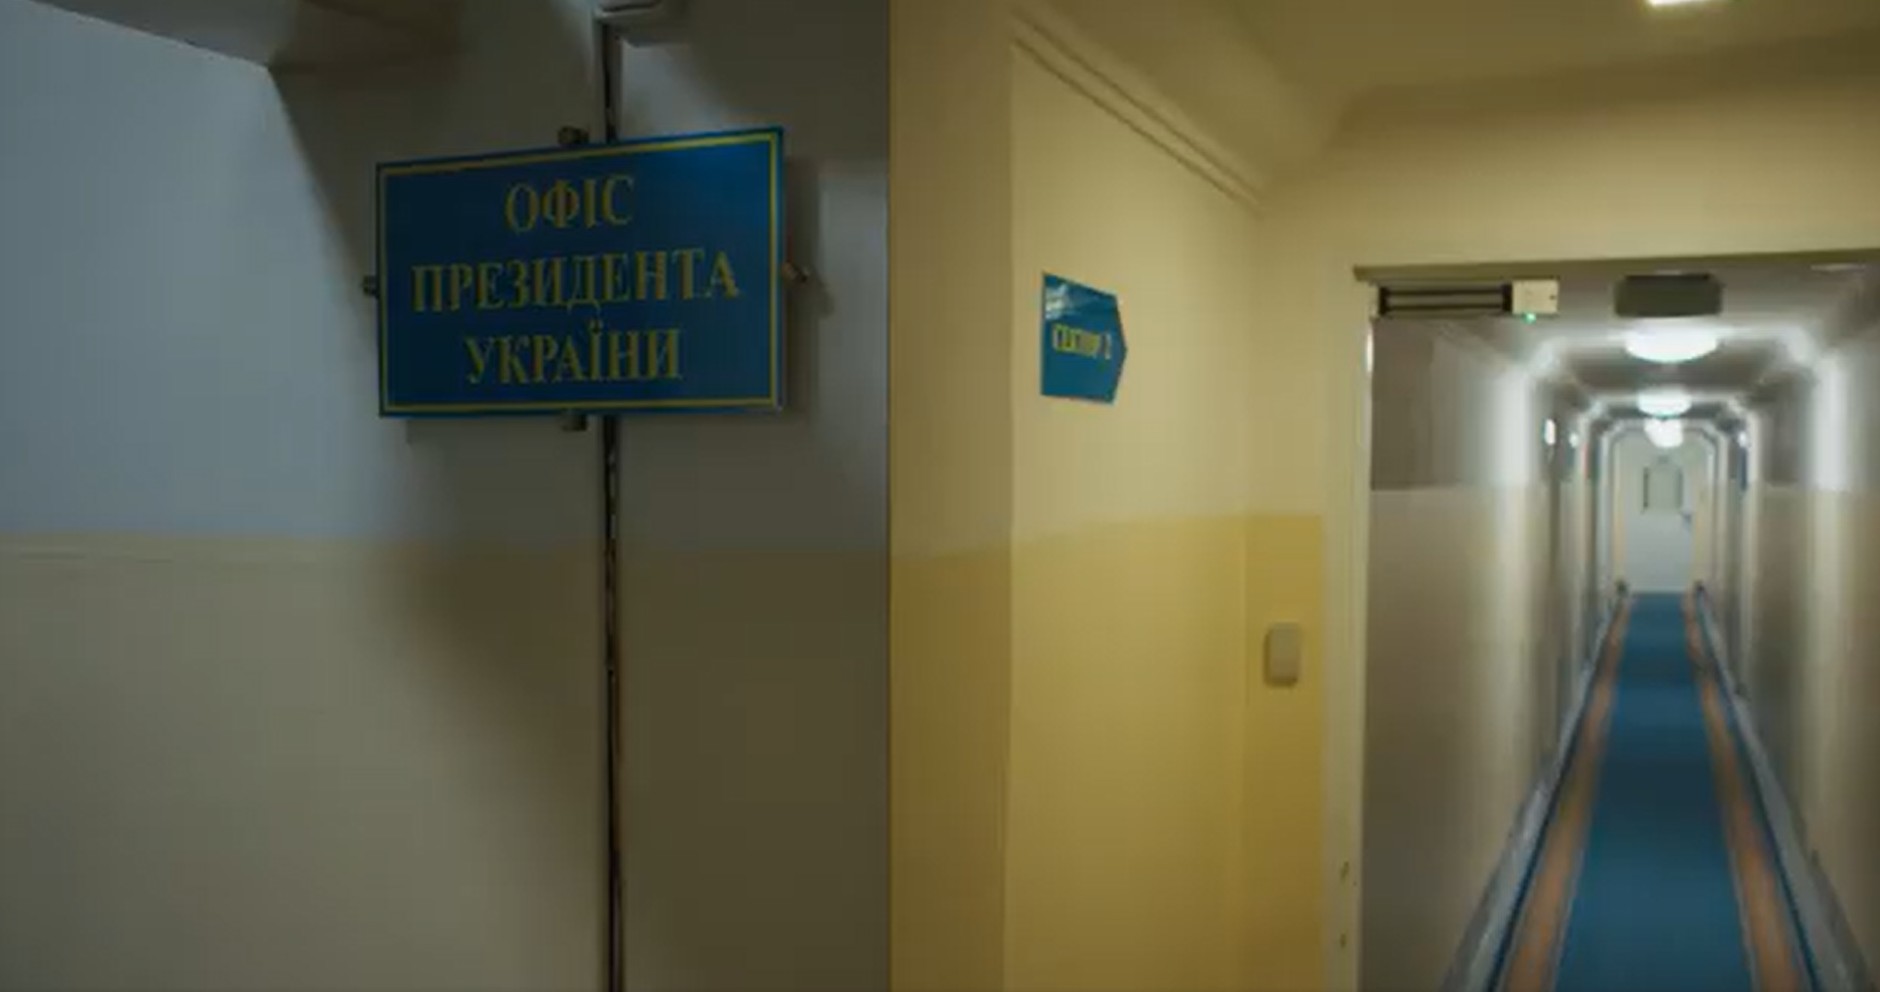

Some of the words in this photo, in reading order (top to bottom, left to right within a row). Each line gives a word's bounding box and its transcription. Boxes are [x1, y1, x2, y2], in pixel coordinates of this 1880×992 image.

[505, 175, 633, 233] ОФІС
[411, 249, 740, 313] ПРЕЗИДЕНТА
[464, 319, 682, 384] УКРАЇНИ
